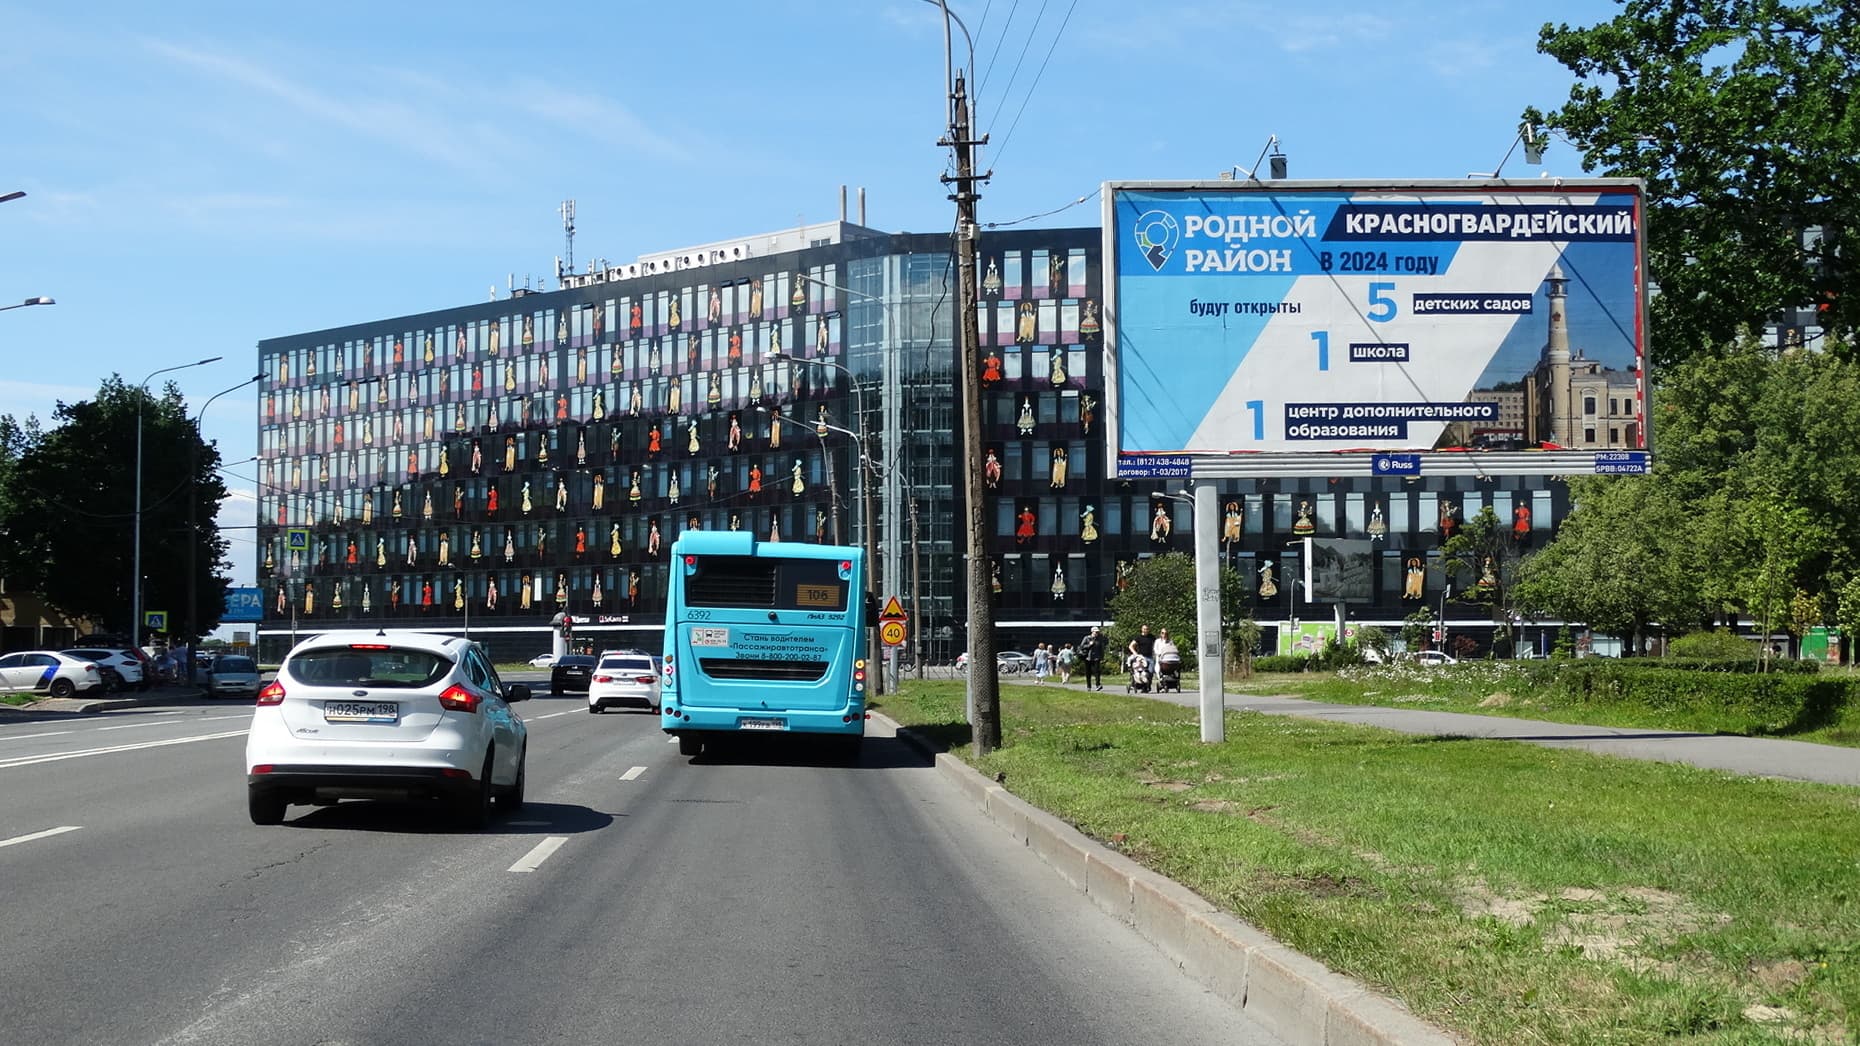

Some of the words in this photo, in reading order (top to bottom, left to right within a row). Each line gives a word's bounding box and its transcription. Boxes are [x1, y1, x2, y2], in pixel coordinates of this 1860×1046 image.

[1184, 210, 1317, 243] РОДНОЙ
[1346, 210, 1632, 237] КРАСНОГВАРДЕЙСКИЙ
[1185, 244, 1293, 272] РАЙОН
[1321, 252, 1333, 271] В
[1340, 252, 1388, 271] 2024
[1395, 256, 1439, 275] году
[1190, 299, 1230, 317] будут
[1234, 301, 1301, 317] открыты
[1366, 282, 1398, 323] 5
[1414, 298, 1480, 311] детских
[1484, 298, 1531, 311] садов
[1311, 330, 1329, 371] 1
[1353, 346, 1406, 358] школа
[1246, 400, 1264, 440] 1
[1288, 406, 1339, 420] центр
[1343, 405, 1492, 420] дополнительного
[1288, 423, 1398, 438] образования
[1136, 458, 1155, 466] (812)
[1391, 460, 1414, 469] Russ
[1118, 469, 1151, 477] договор:
[808, 589, 828, 600] 106
[687, 611, 711, 620] 6392
[886, 628, 900, 638] 40
